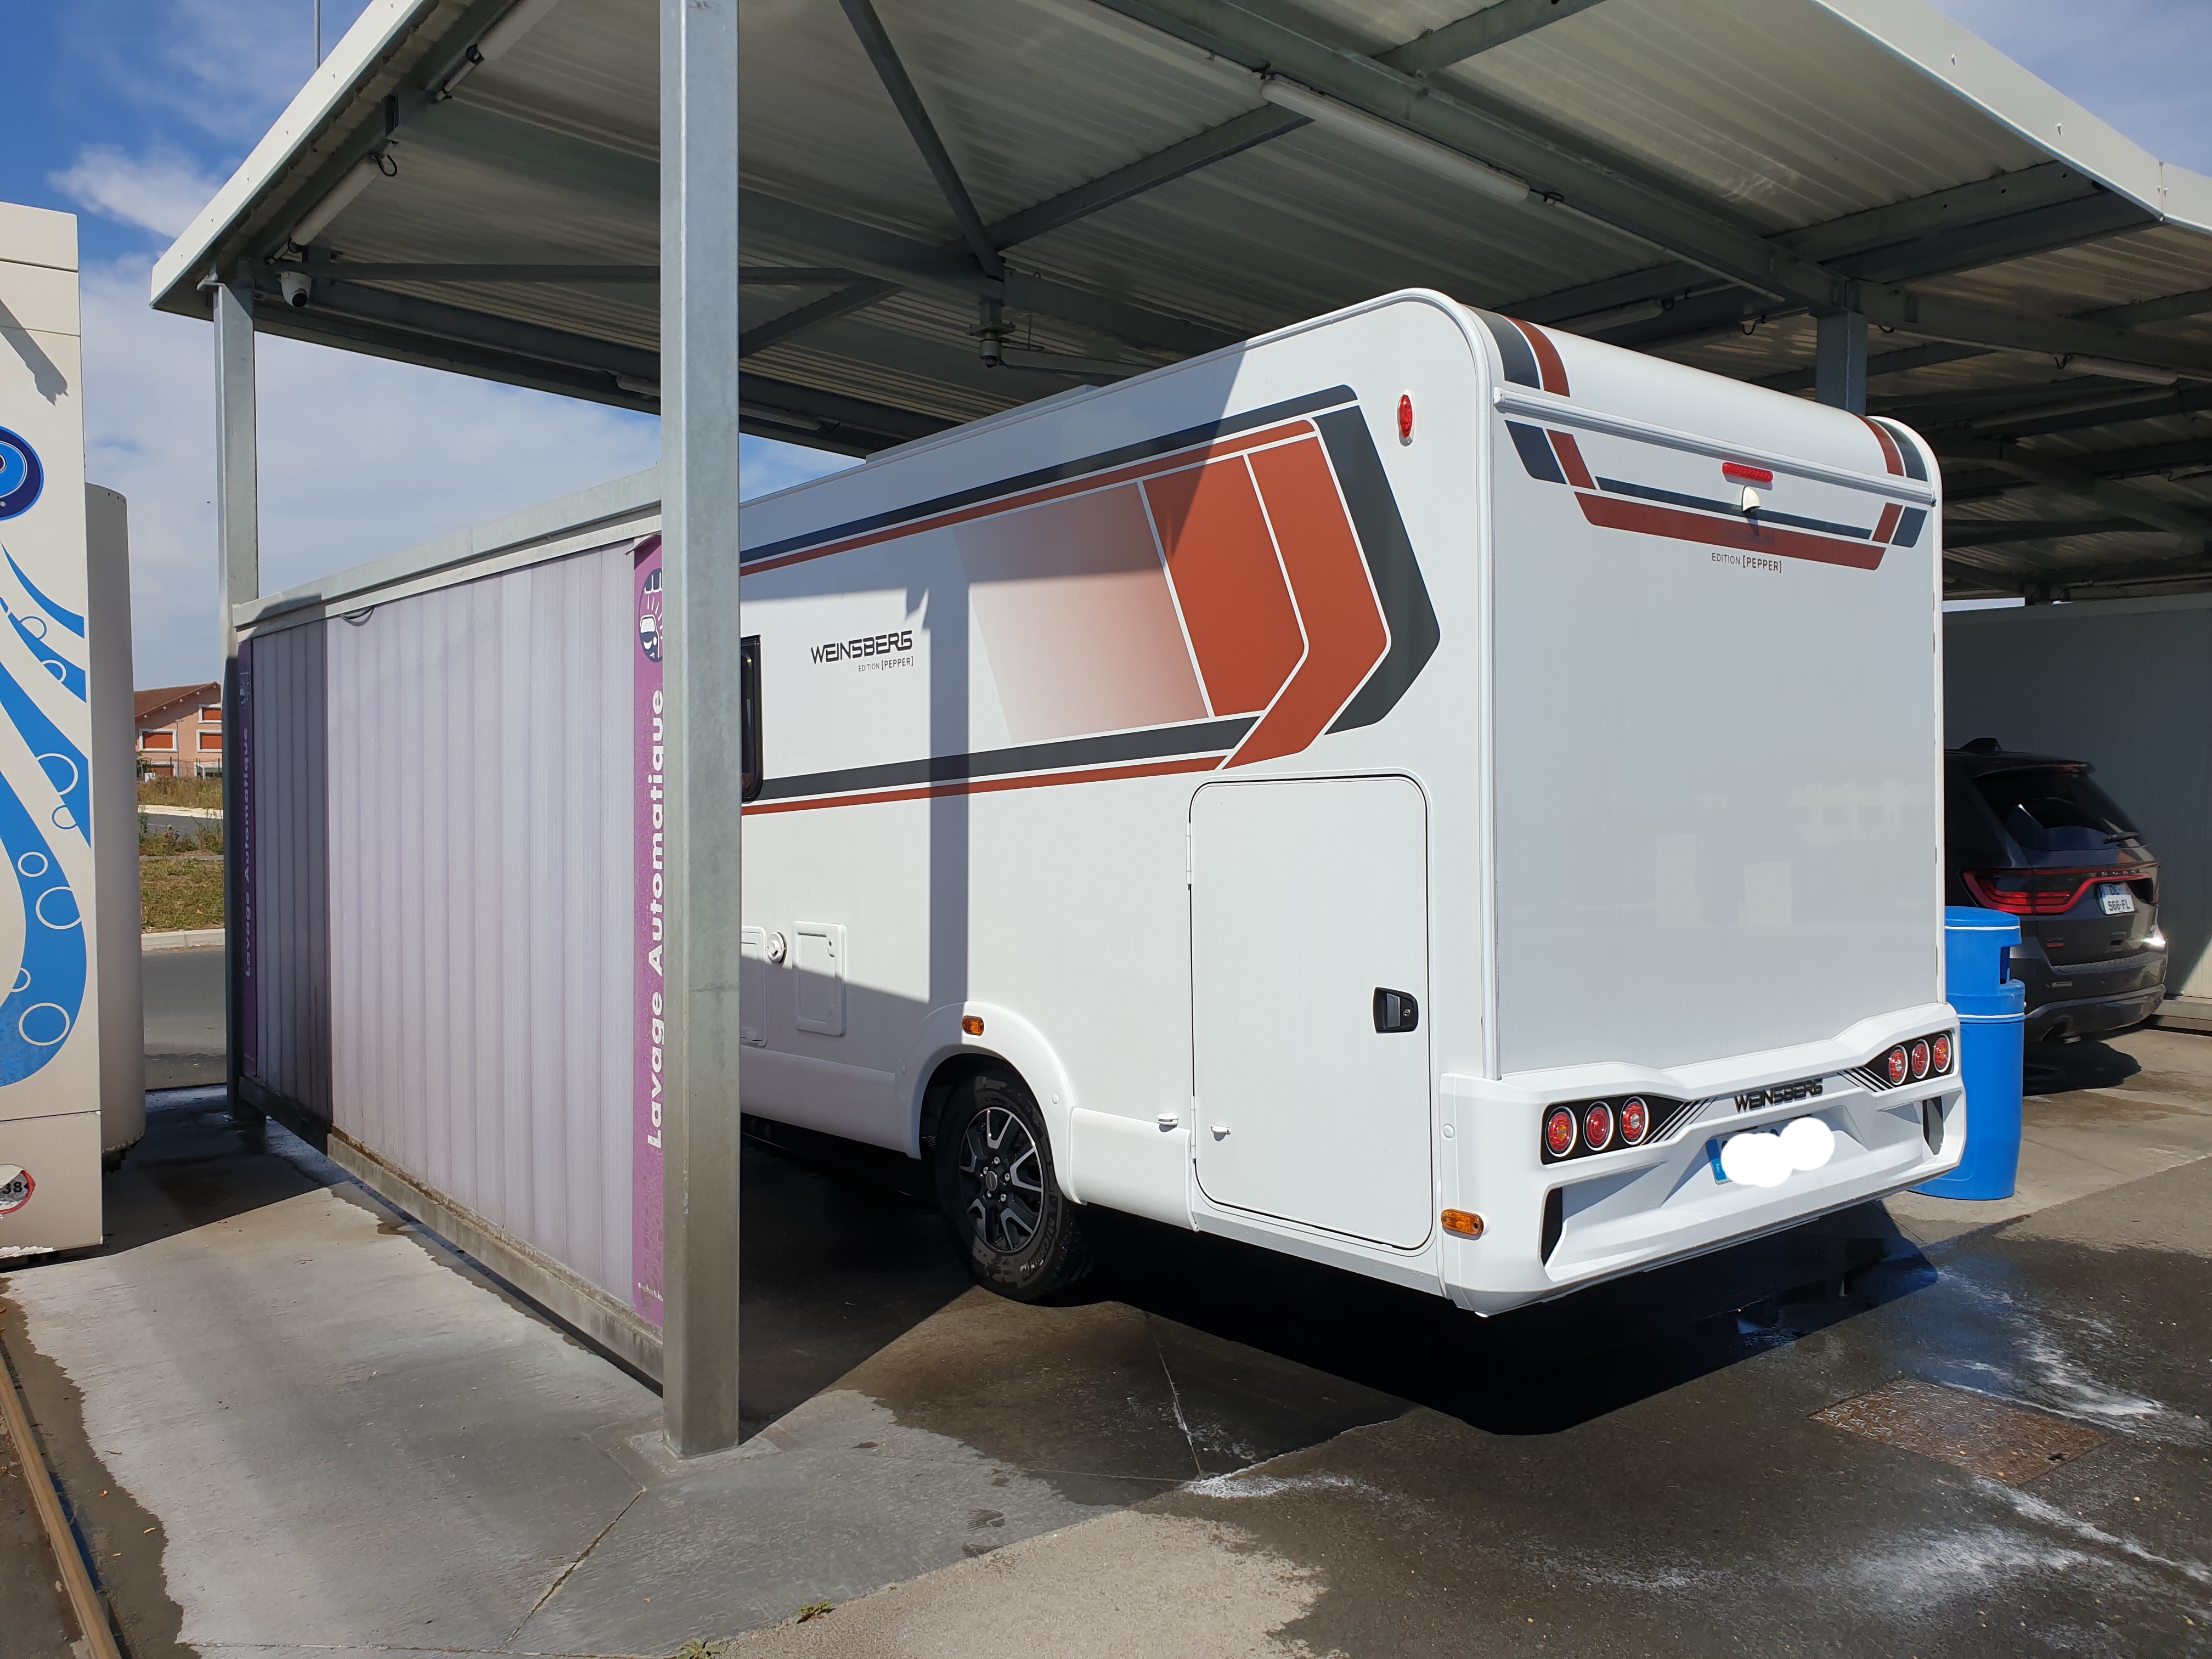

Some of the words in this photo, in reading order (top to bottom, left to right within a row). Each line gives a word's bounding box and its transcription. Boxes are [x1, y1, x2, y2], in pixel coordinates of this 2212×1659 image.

[1712, 552, 1740, 565] EDITION
[1743, 555, 1782, 574] [PEPPER]
[811, 630, 913, 664] WEINSBERG
[858, 663, 880, 672] EDITION
[881, 656, 913, 670] [PEPPER]
[648, 690, 663, 975] Automatique
[2108, 899, 2131, 911] 566-FL
[648, 991, 663, 1148] Lavage
[1734, 1078, 1823, 1114] WEINSBERG
